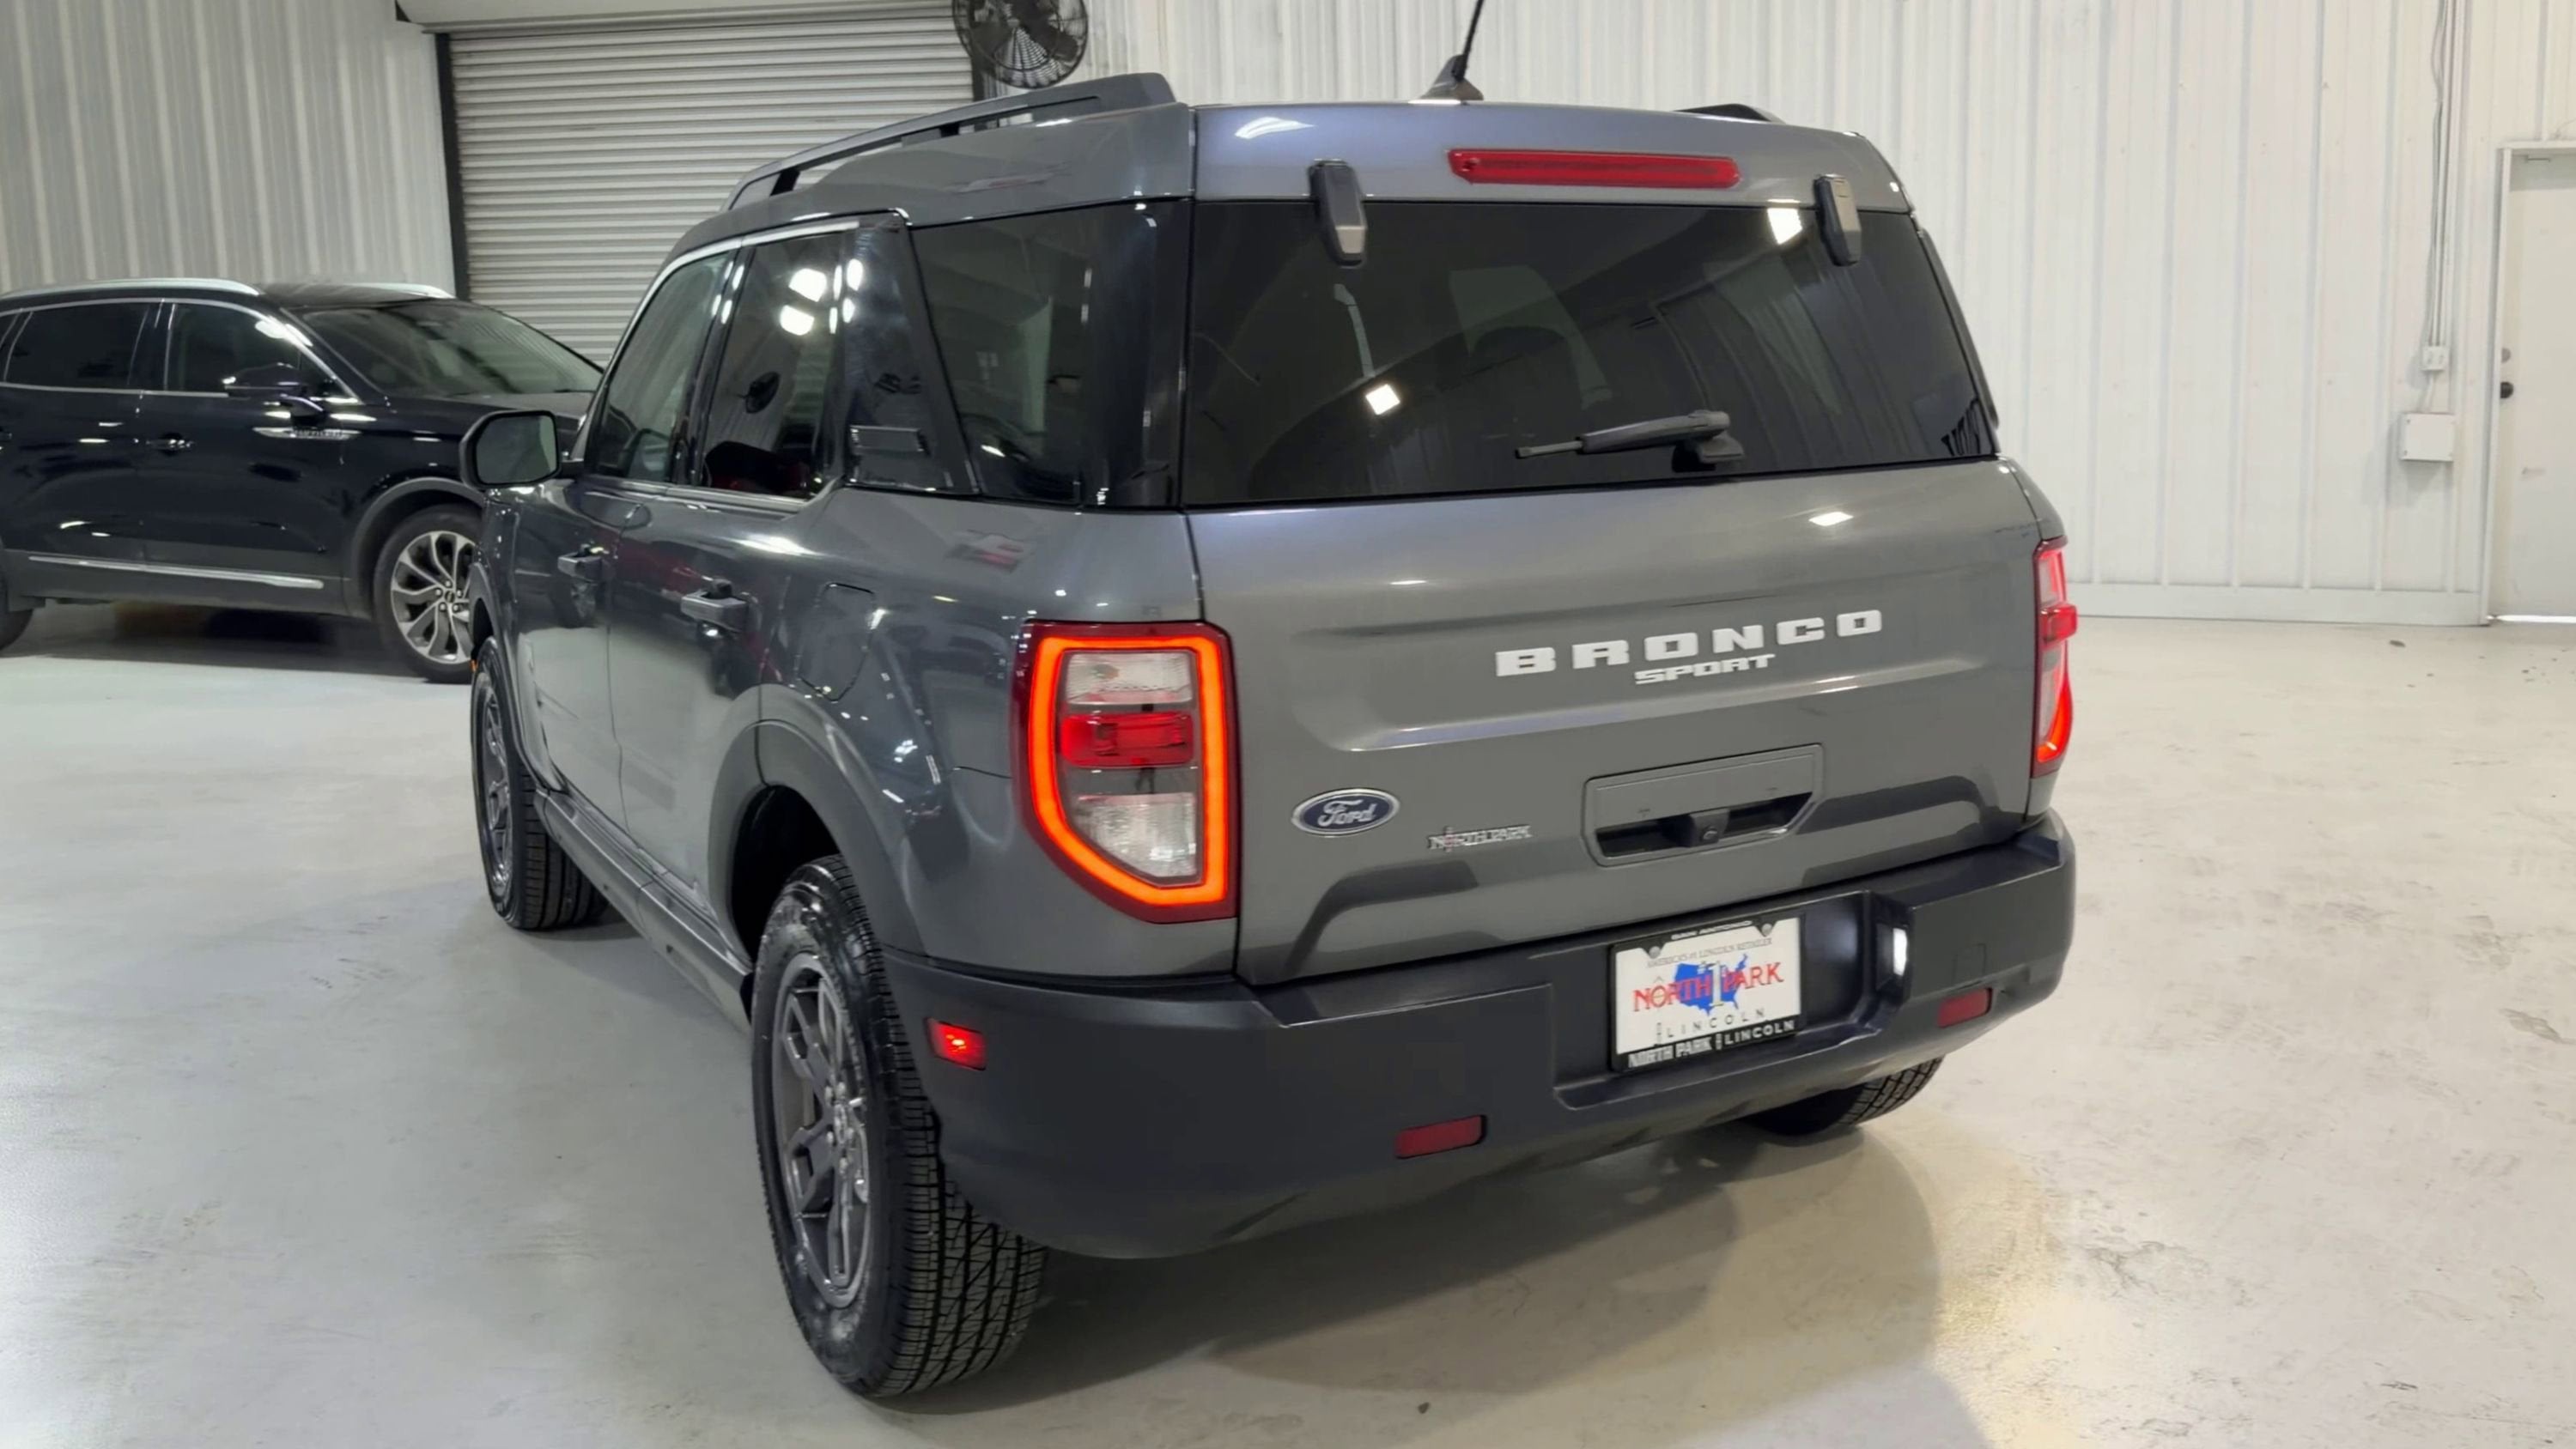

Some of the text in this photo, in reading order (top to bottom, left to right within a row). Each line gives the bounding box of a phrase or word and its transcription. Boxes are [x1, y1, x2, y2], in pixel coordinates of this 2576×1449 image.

[1496, 609, 1882, 676] BRONCO
[1635, 653, 1776, 685] SPORT
[1317, 799, 1378, 827] Ford
[1633, 961, 1784, 1012] NORTH PARK
[1667, 1008, 1765, 1038] LINCOLN
[1724, 1020, 1795, 1045] LINCOLN
